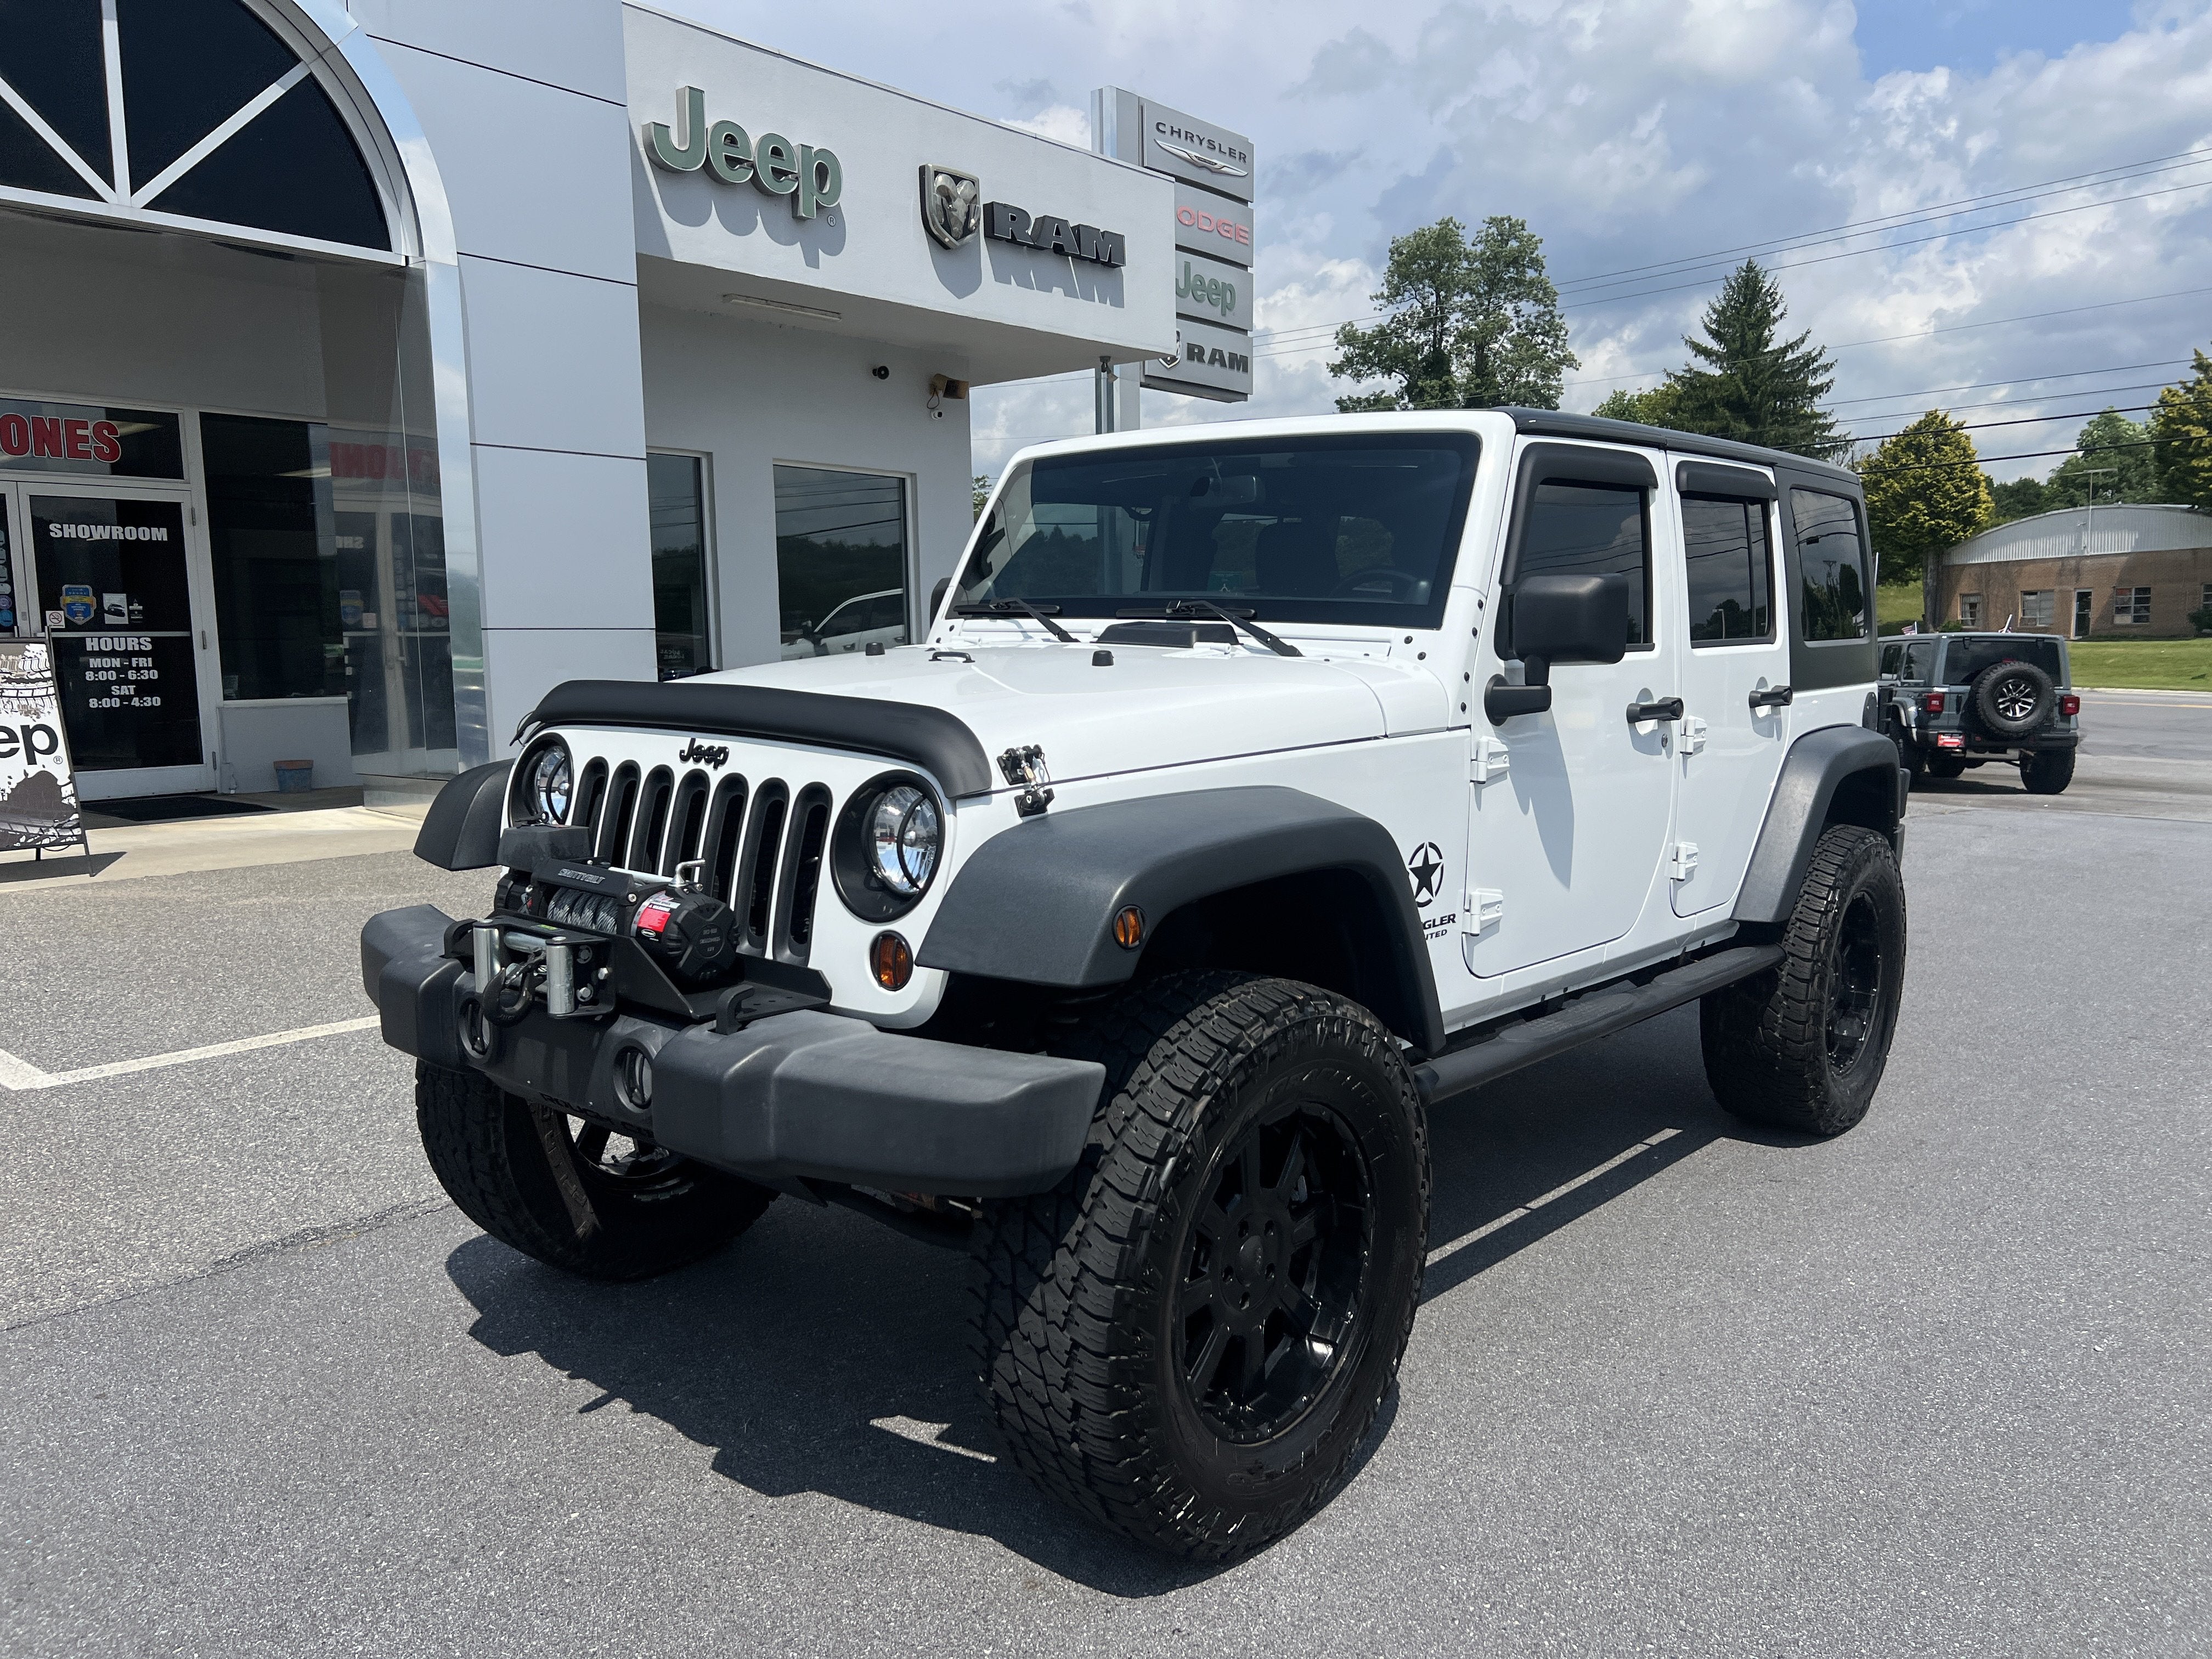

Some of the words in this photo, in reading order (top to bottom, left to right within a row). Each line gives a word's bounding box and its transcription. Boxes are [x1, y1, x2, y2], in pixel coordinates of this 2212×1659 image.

[642, 86, 843, 219] Jeep
[1155, 122, 1247, 163] CHRYSLER
[983, 201, 1126, 268] RAM
[1176, 206, 1249, 245] ODGE
[1176, 261, 1236, 317] Jeep
[1186, 342, 1249, 374] RAM
[0, 413, 121, 463] ONES
[49, 523, 168, 541] SHOWROOM
[86, 637, 153, 651] HOURS
[85, 670, 117, 681] 8:00
[127, 670, 159, 680] 6:30
[89, 658, 121, 668] MON
[132, 657, 153, 668] FRI
[89, 697, 120, 708] 8:00
[131, 697, 161, 707] 4:30
[111, 685, 136, 695] SAT
[679, 738, 730, 770] Jeep
